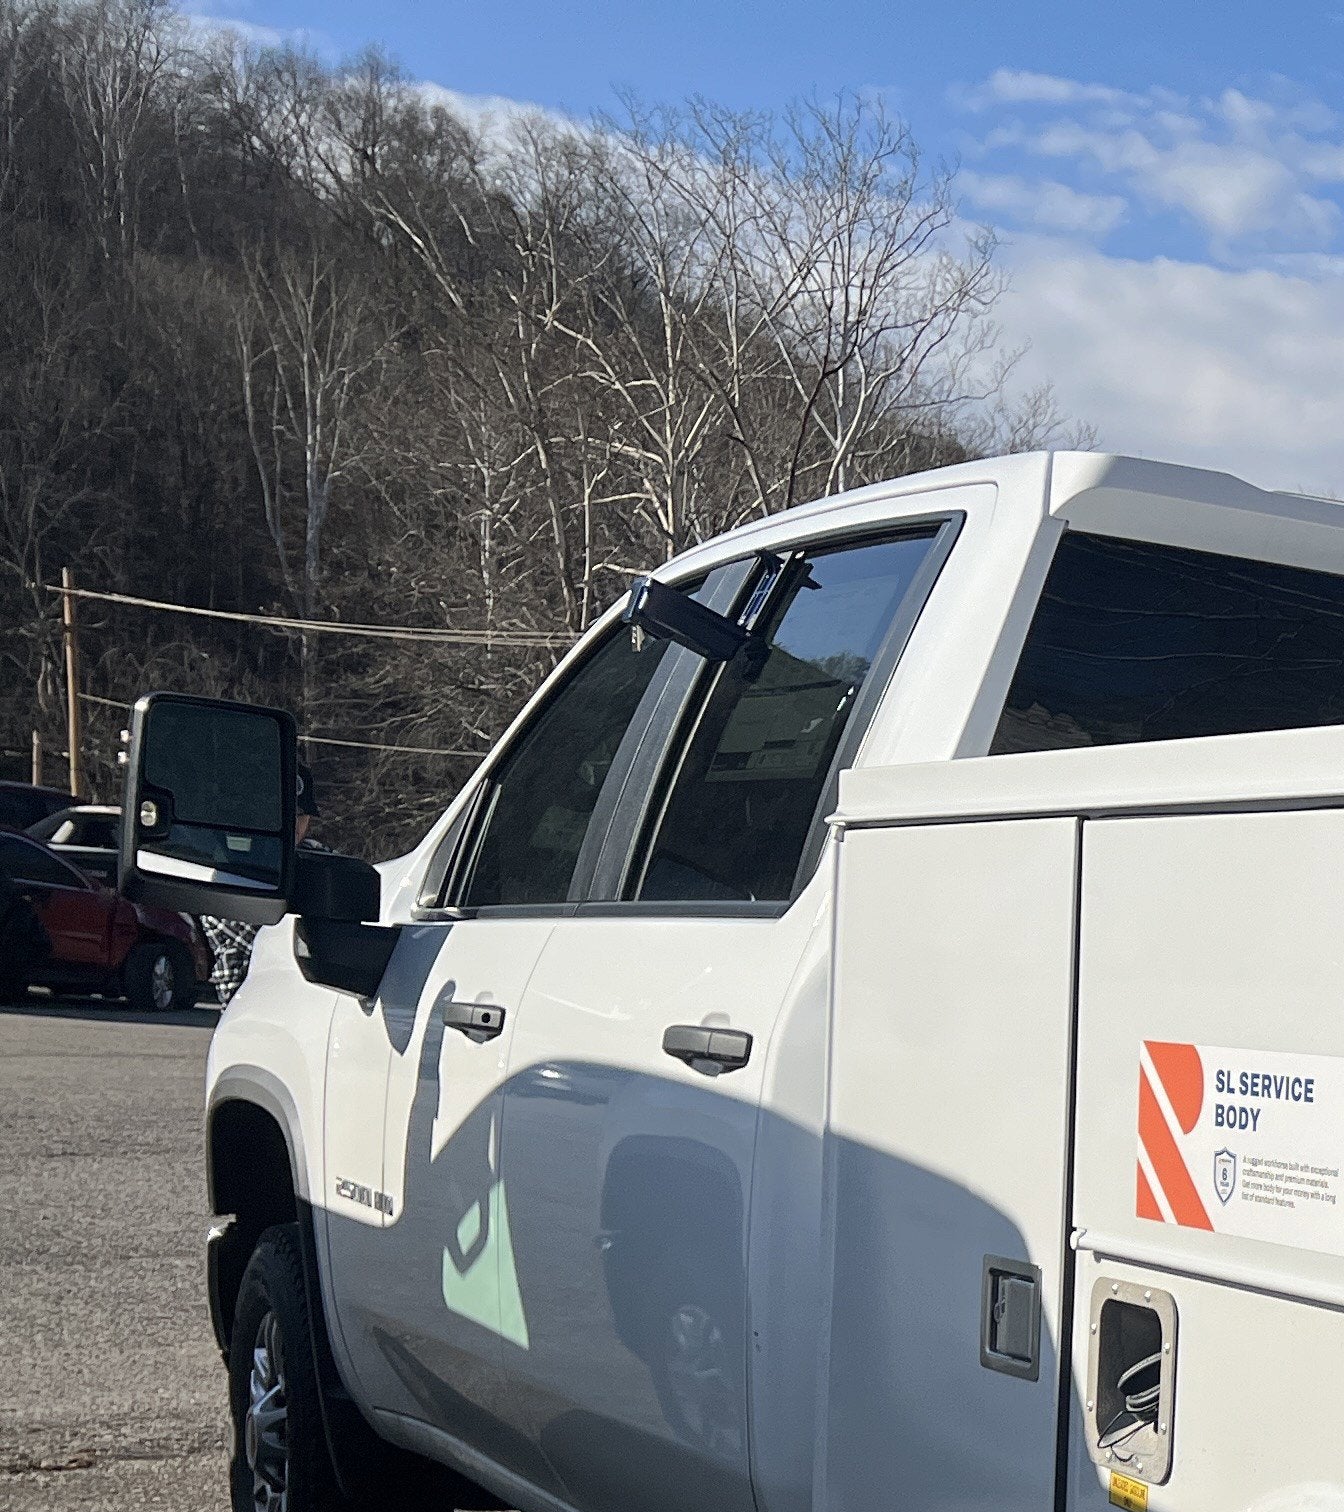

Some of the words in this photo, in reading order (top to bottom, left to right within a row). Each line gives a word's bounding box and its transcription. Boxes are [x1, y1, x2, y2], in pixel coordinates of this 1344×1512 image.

[1215, 1069, 1235, 1094] SL
[1239, 1071, 1315, 1103] SERVICE
[1214, 1103, 1261, 1132] BODY
[1222, 1168, 1228, 1181] 6
